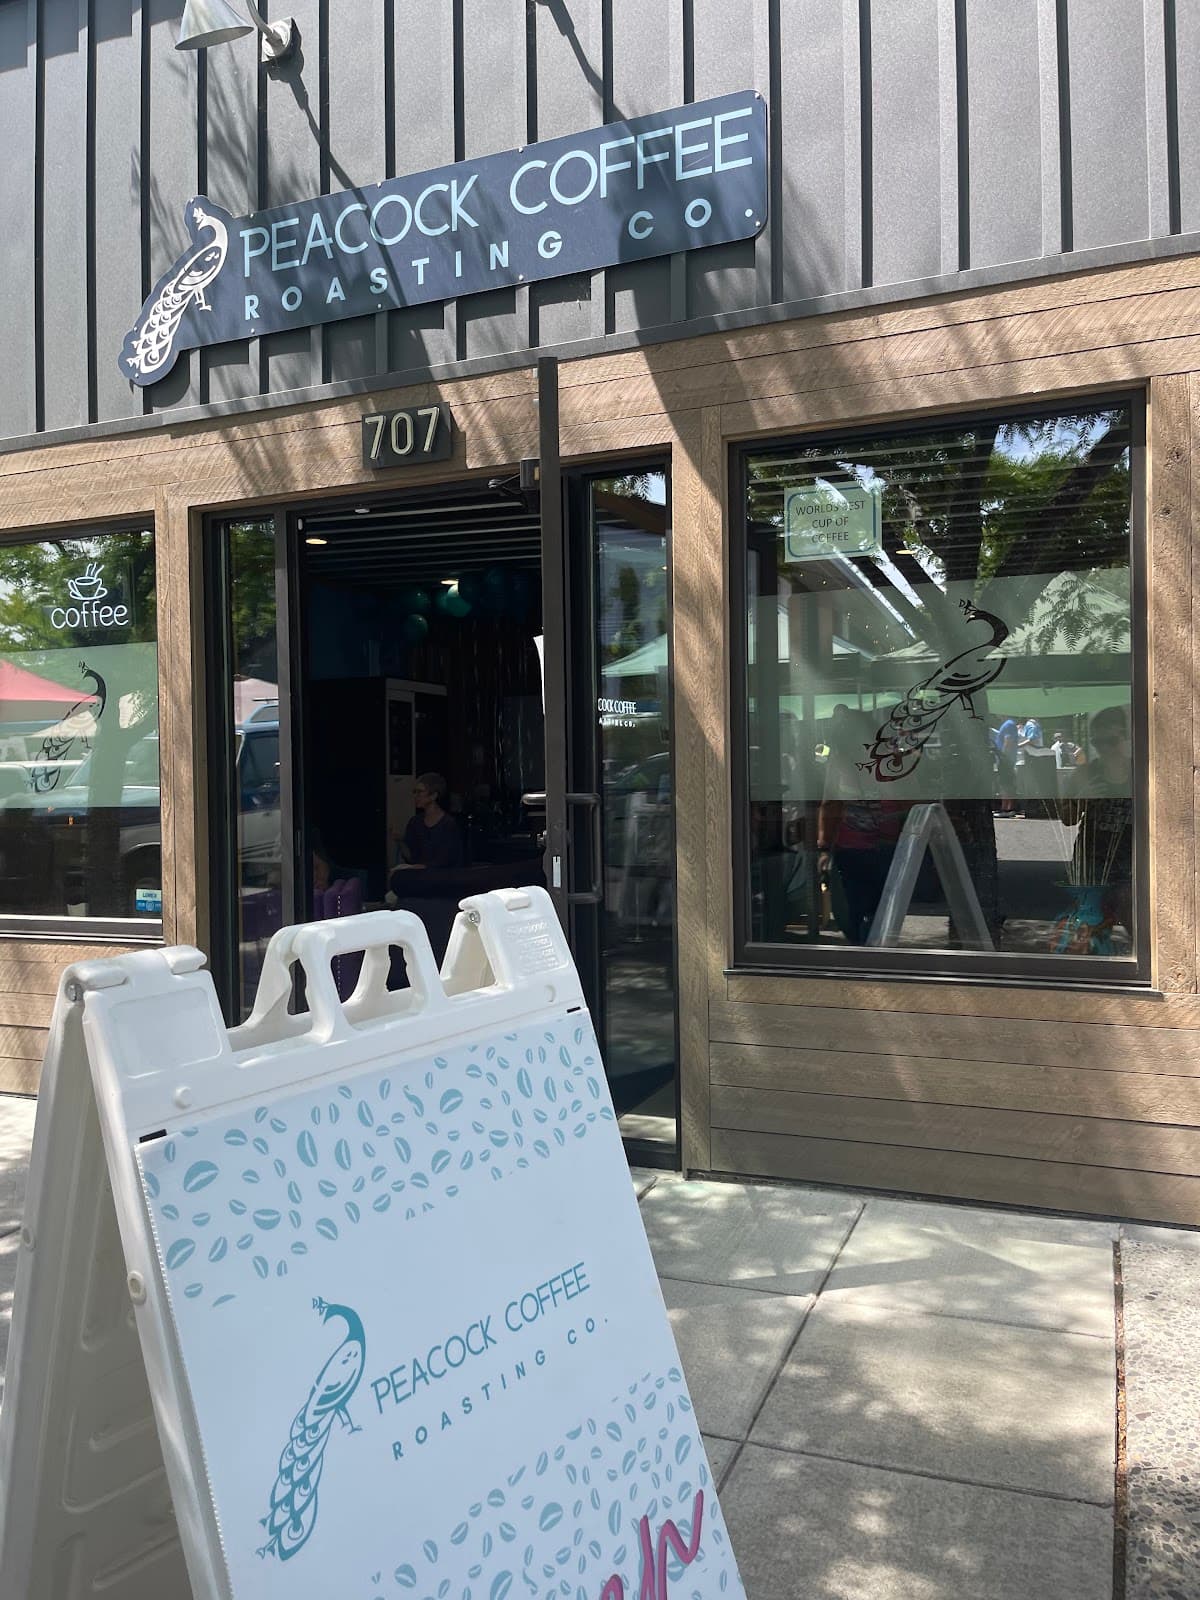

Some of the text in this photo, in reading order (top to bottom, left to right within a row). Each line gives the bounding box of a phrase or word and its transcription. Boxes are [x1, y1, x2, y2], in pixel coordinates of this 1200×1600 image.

[240, 106, 753, 278] PEACOCK COFFEE
[244, 197, 753, 320] ROASTING CO.
[364, 406, 440, 460] 707
[811, 531, 849, 544] COFFEE
[812, 516, 849, 529] CUP OF
[51, 600, 129, 629] coffee
[597, 698, 637, 715] COCK COFFEE
[370, 1261, 591, 1415] PEACOCK COFFEE
[392, 1317, 609, 1461] ROASTING CO.
